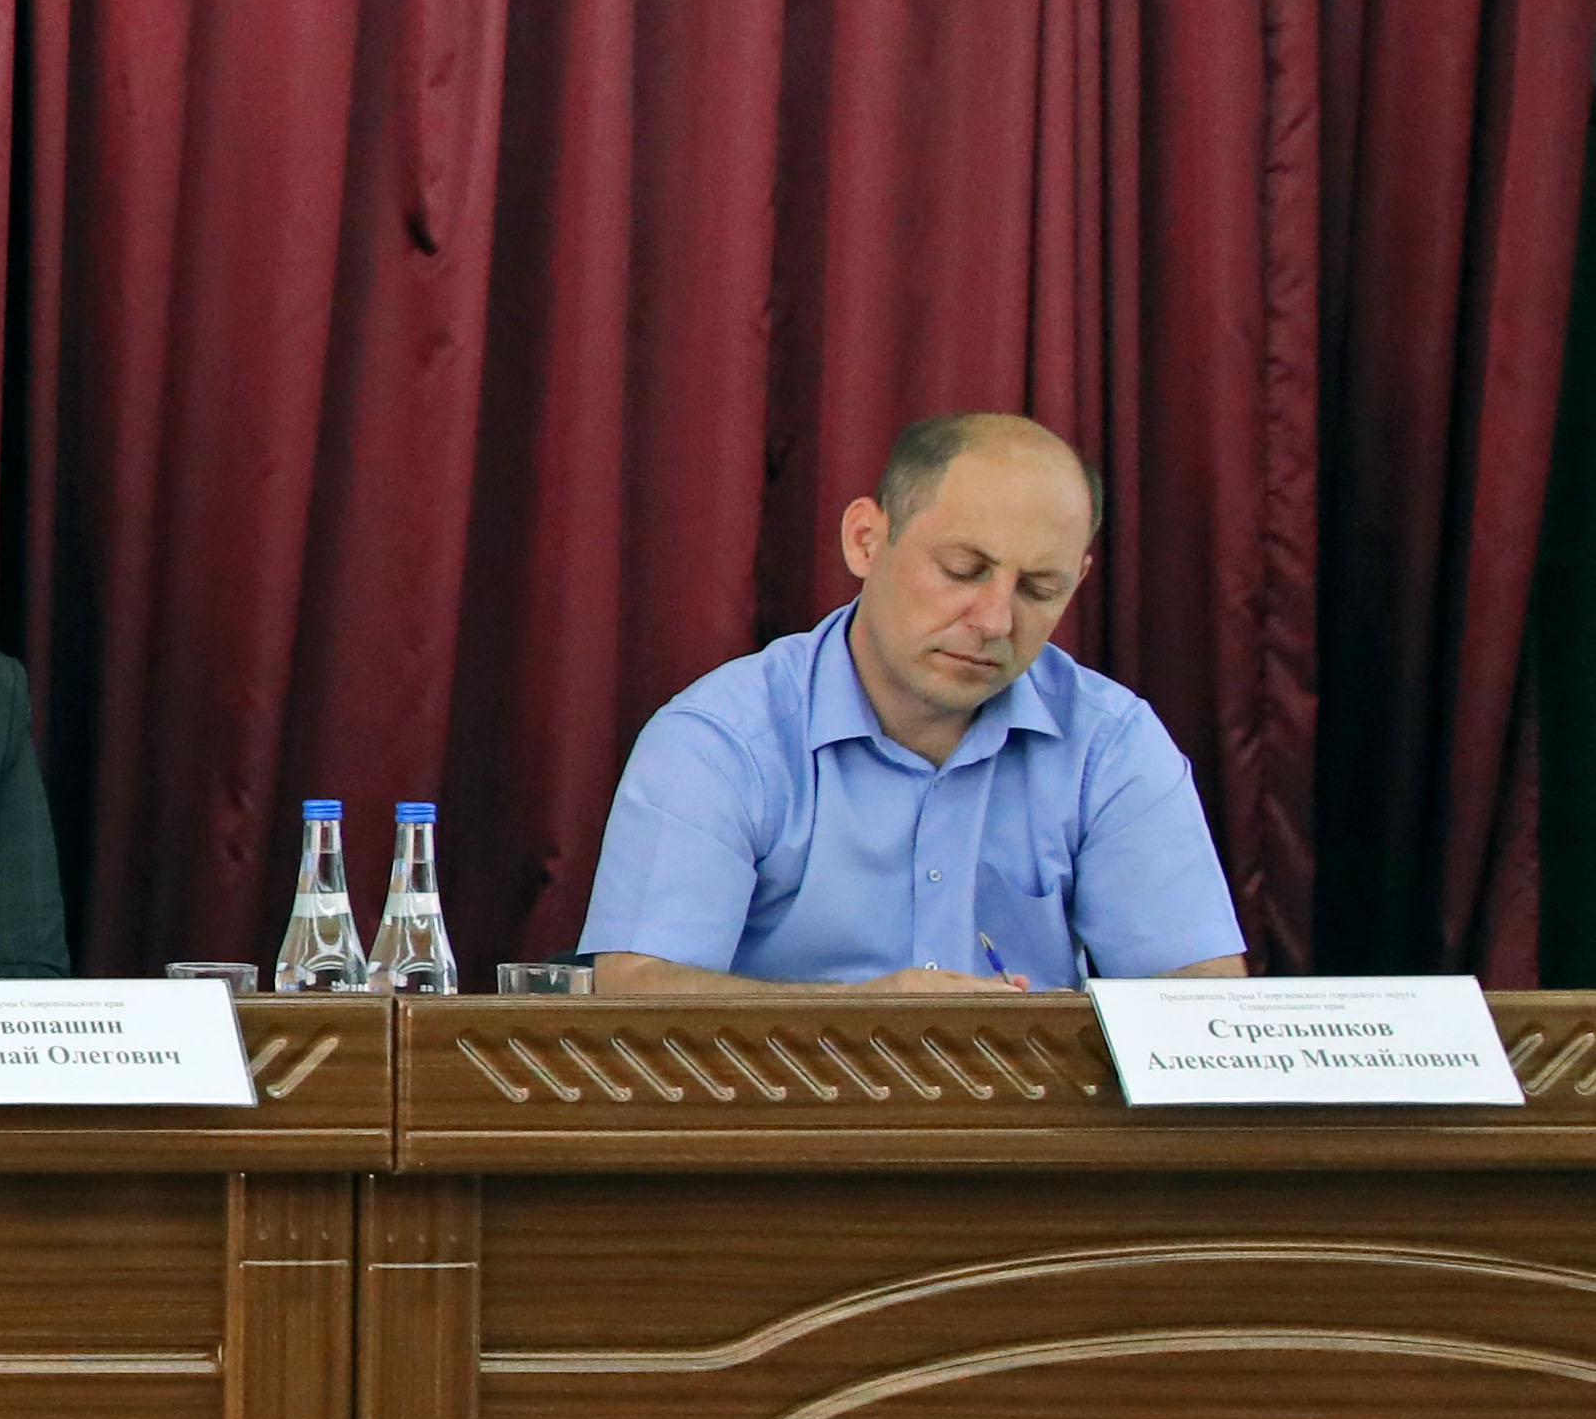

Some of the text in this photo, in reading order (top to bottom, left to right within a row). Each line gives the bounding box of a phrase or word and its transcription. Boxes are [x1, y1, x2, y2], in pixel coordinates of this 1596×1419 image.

[1208, 1019, 1394, 1043] Стрельников
[48, 1046, 180, 1064] Олегович
[1149, 1049, 1480, 1073] Александр Михайлович
